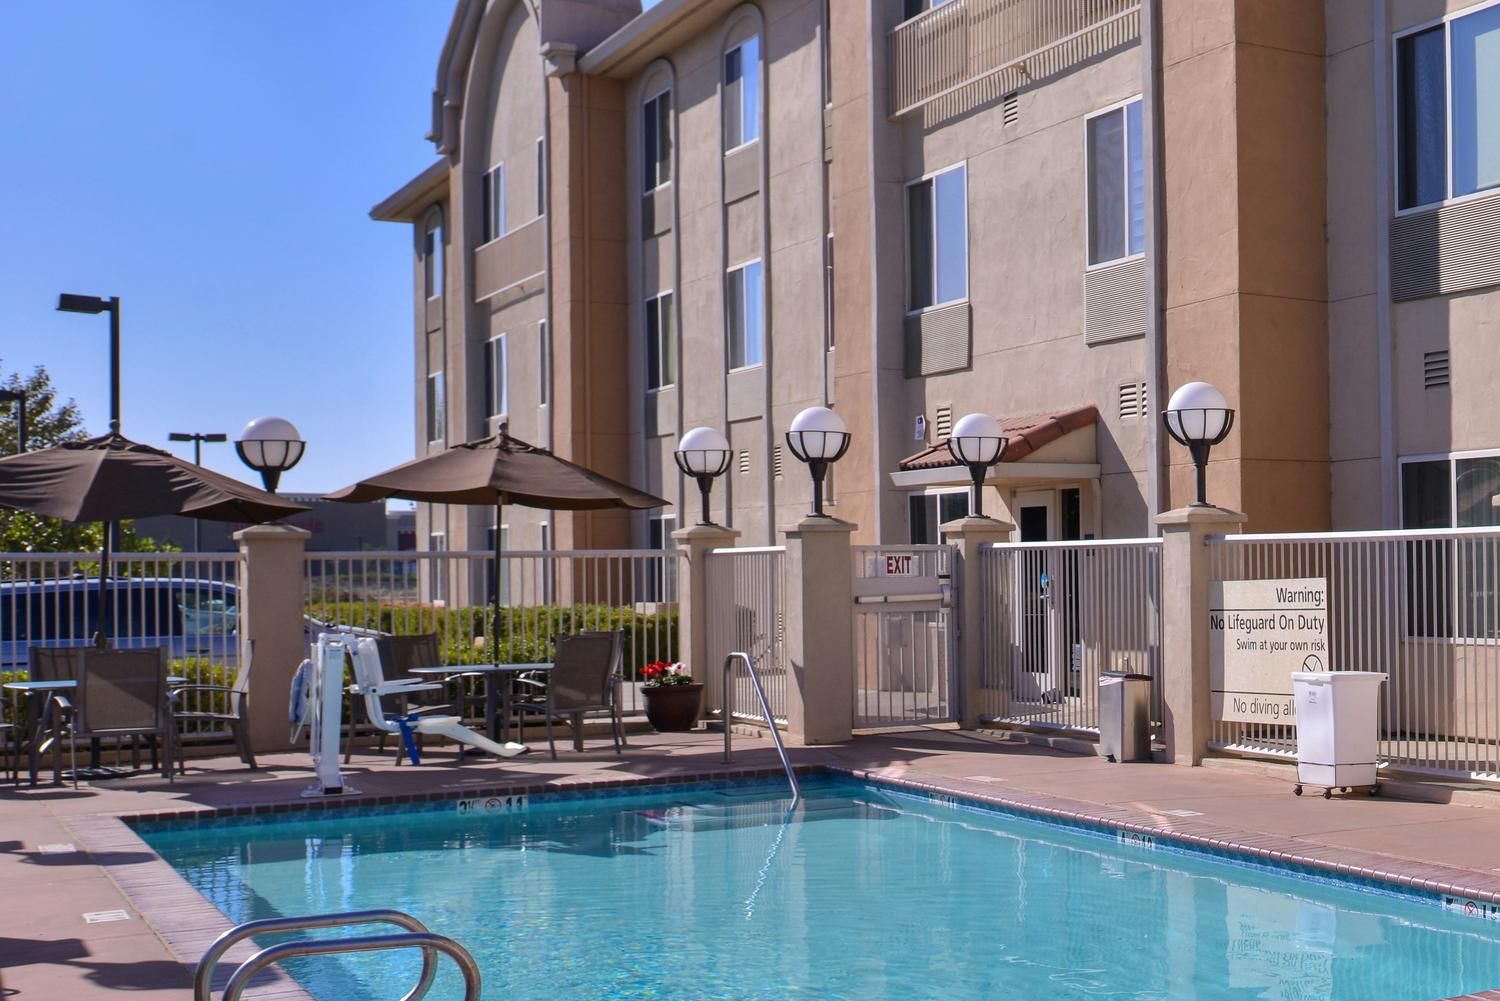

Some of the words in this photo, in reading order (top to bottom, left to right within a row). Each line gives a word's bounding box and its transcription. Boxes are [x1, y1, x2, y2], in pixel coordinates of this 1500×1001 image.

[886, 555, 912, 574] EXIT
[1276, 586, 1324, 607] Warning:
[1210, 614, 1225, 631] No
[1227, 613, 1276, 634] Lifeguard
[1279, 614, 1295, 631] On
[1298, 614, 1325, 634] Duty
[1236, 637, 1257, 651] Swim
[1260, 639, 1267, 651] at
[1269, 640, 1287, 654] your
[1289, 640, 1308, 651] own
[1311, 638, 1326, 652] risk
[1233, 697, 1247, 714] No
[1250, 697, 1280, 719] diving
